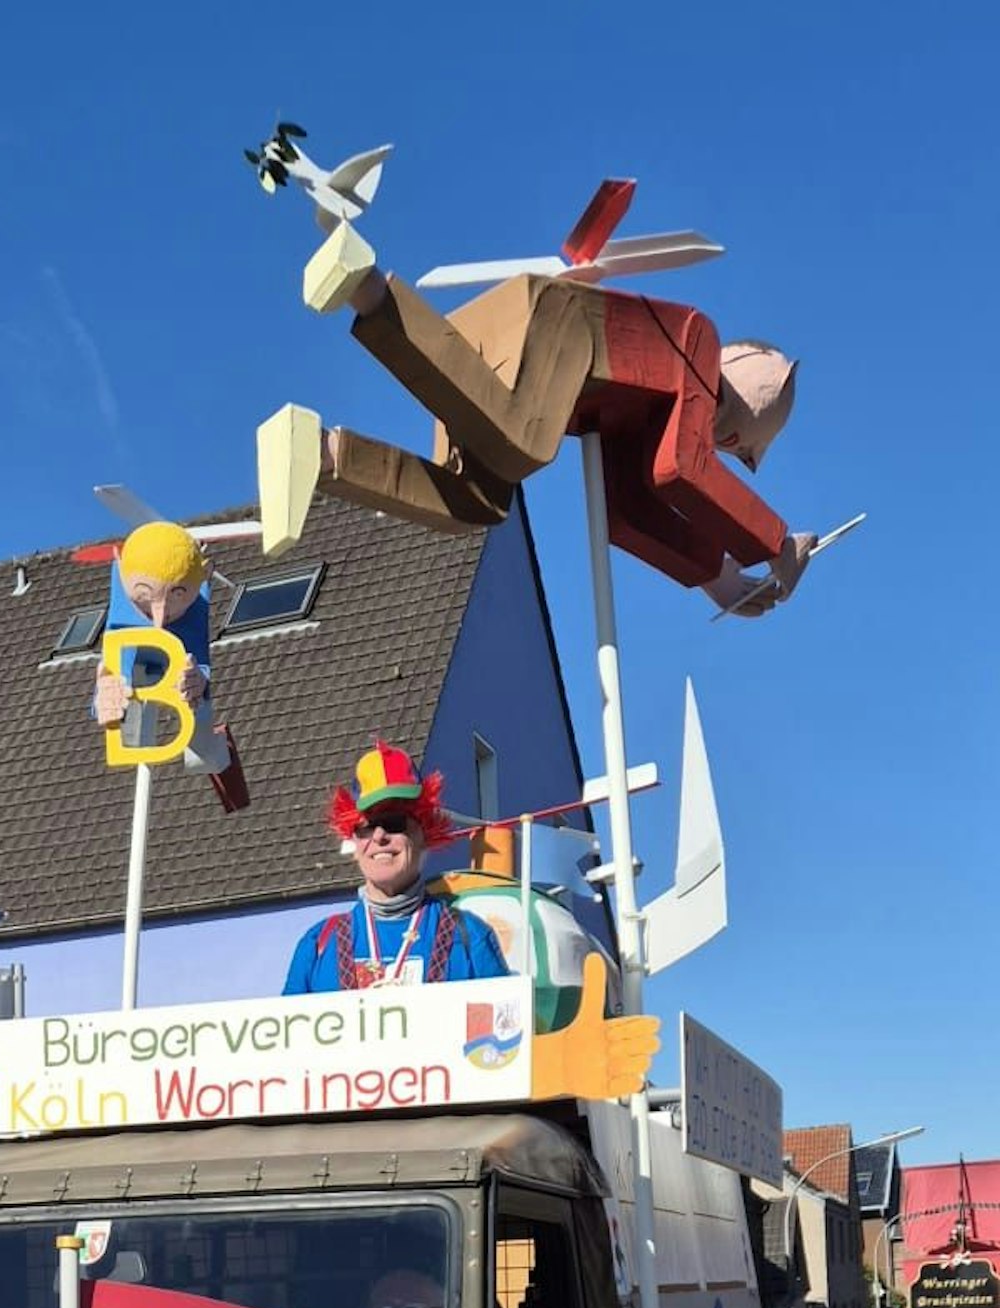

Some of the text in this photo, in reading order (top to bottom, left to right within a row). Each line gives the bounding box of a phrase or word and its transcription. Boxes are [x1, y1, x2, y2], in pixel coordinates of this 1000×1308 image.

[43, 998, 408, 1068] Bürgerverein
[10, 1065, 451, 1130] Köln Worringen
